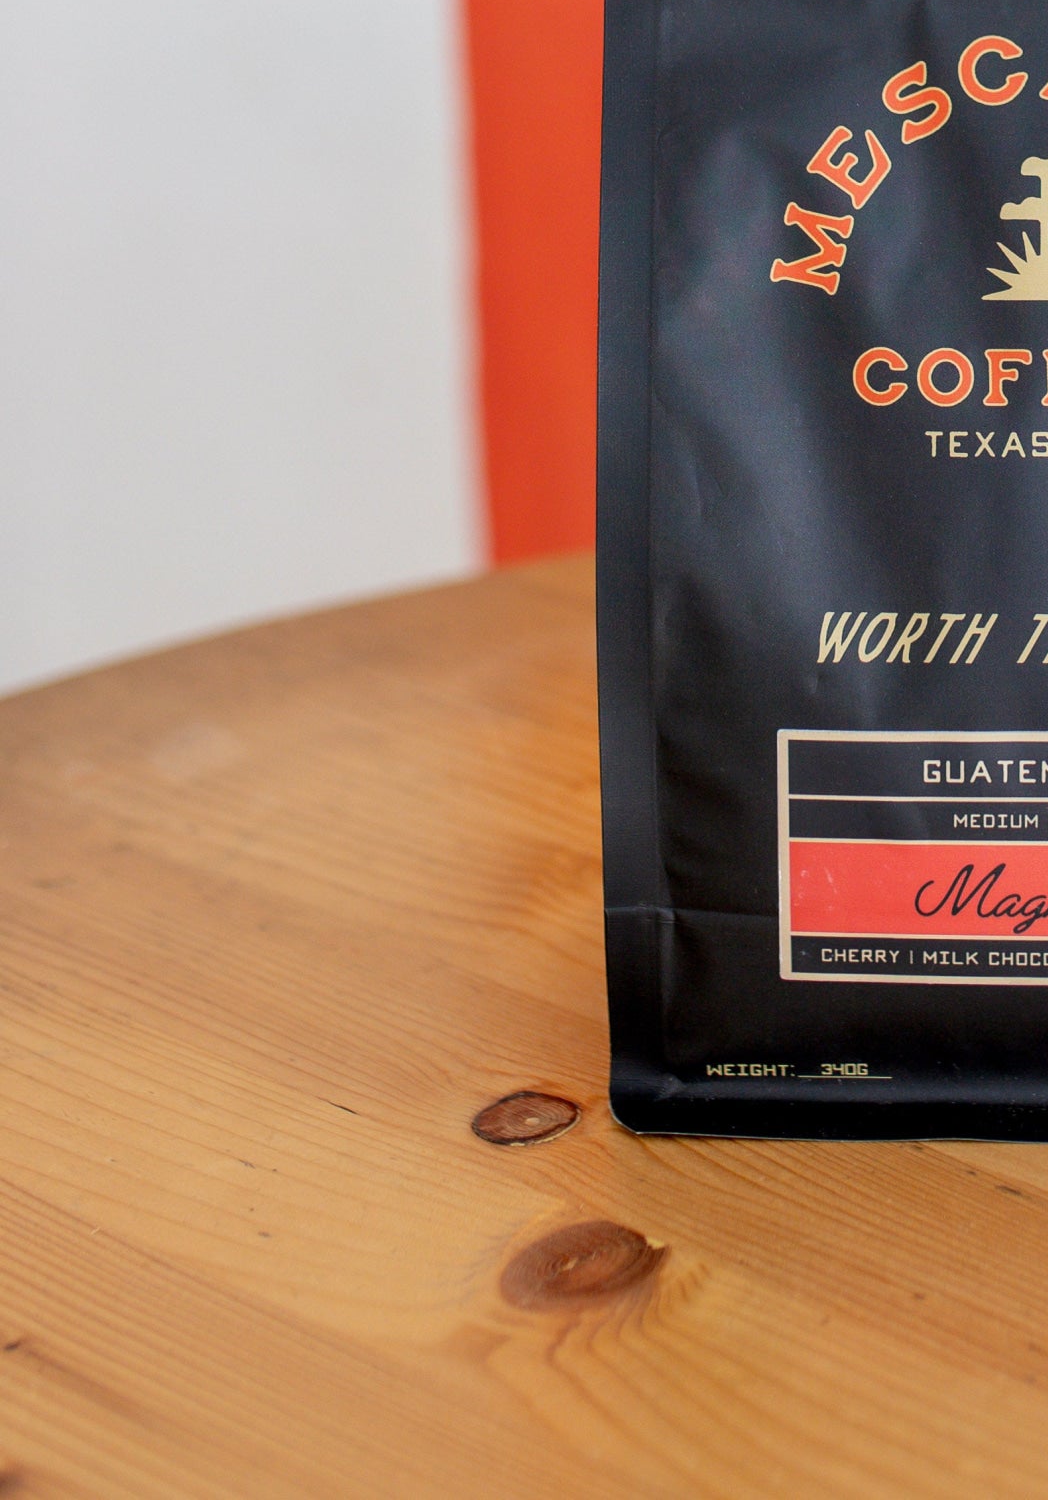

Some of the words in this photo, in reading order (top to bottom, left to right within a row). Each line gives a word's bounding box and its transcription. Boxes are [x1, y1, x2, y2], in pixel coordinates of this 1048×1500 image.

[816, 611, 999, 664] WORTH
[952, 813, 1040, 829] MEDIUM
[820, 947, 899, 963] CHERRY
[922, 949, 979, 966] MILK
[706, 1064, 795, 1077] WEIGHT:
[820, 1063, 869, 1076] 340G
